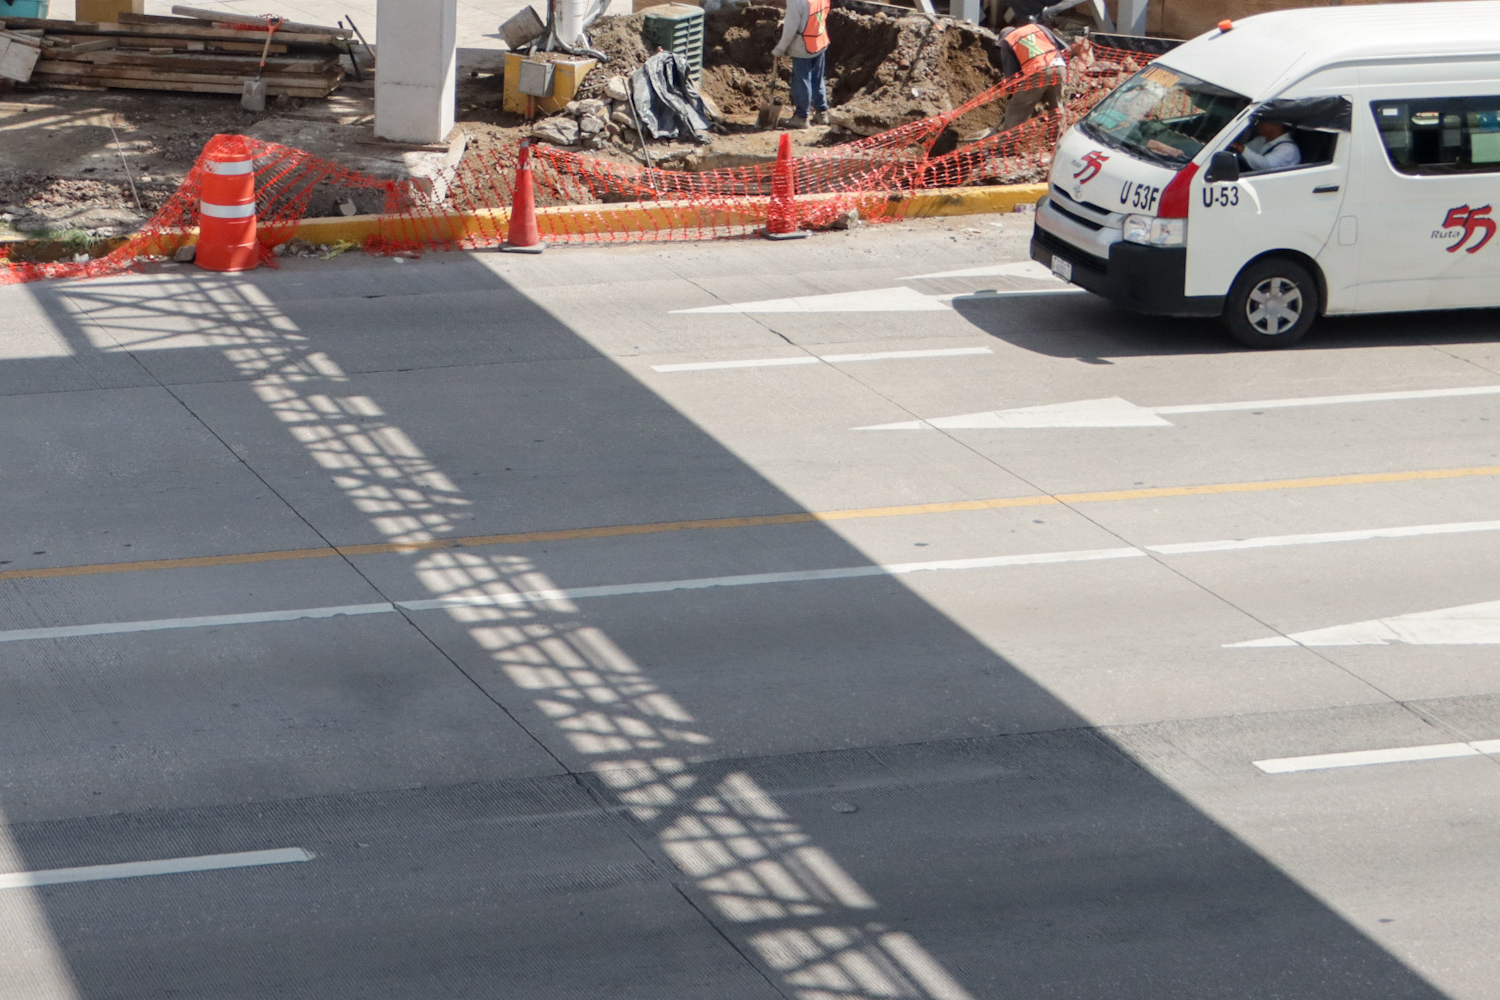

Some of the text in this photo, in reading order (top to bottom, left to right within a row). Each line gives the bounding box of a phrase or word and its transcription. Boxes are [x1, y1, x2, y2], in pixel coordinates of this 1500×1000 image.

[1073, 150, 1110, 185] 55
[1120, 181, 1131, 205] U
[1202, 186, 1239, 208] U-53
[1430, 203, 1497, 254] Ruta 55
